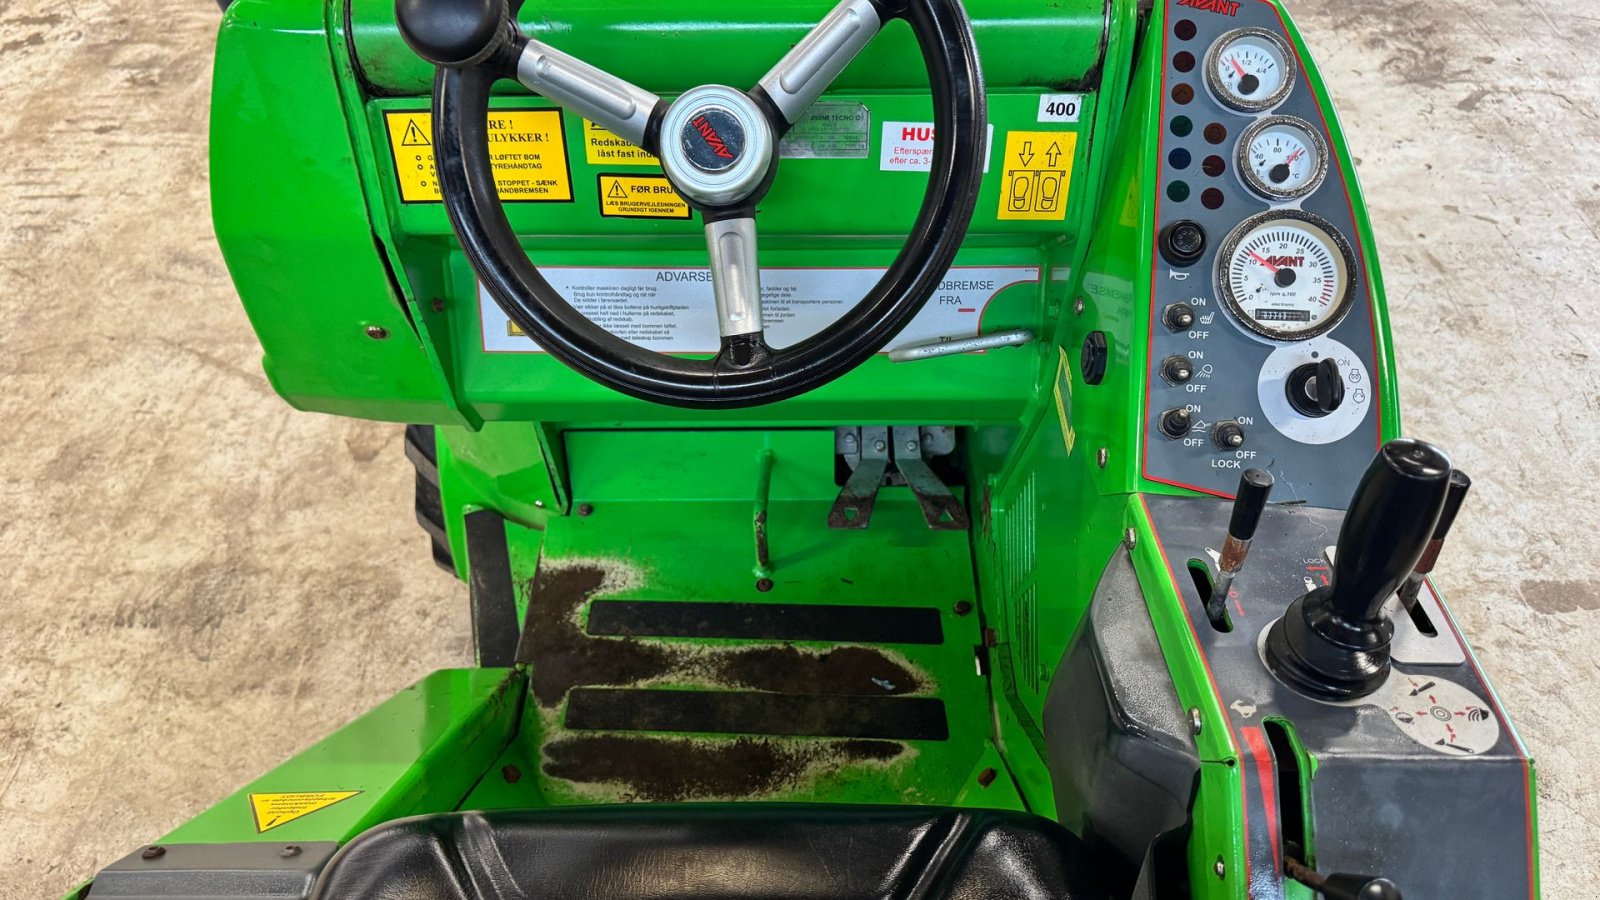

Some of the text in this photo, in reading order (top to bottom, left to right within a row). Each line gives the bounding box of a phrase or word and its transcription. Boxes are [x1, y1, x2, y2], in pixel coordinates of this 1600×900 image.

[1046, 102, 1075, 116] 400
[488, 120, 506, 129] RE
[692, 115, 735, 158] AVANT
[591, 138, 638, 146] Redskab
[656, 272, 712, 282] ADVARSE
[938, 281, 994, 290] DBREMSE
[940, 296, 962, 305] FRA
[1188, 331, 1209, 339] OFF
[1238, 416, 1253, 424] ON
[1184, 438, 1204, 446] OFF
[1236, 451, 1256, 459] OFF
[1211, 460, 1241, 469] LOCK
